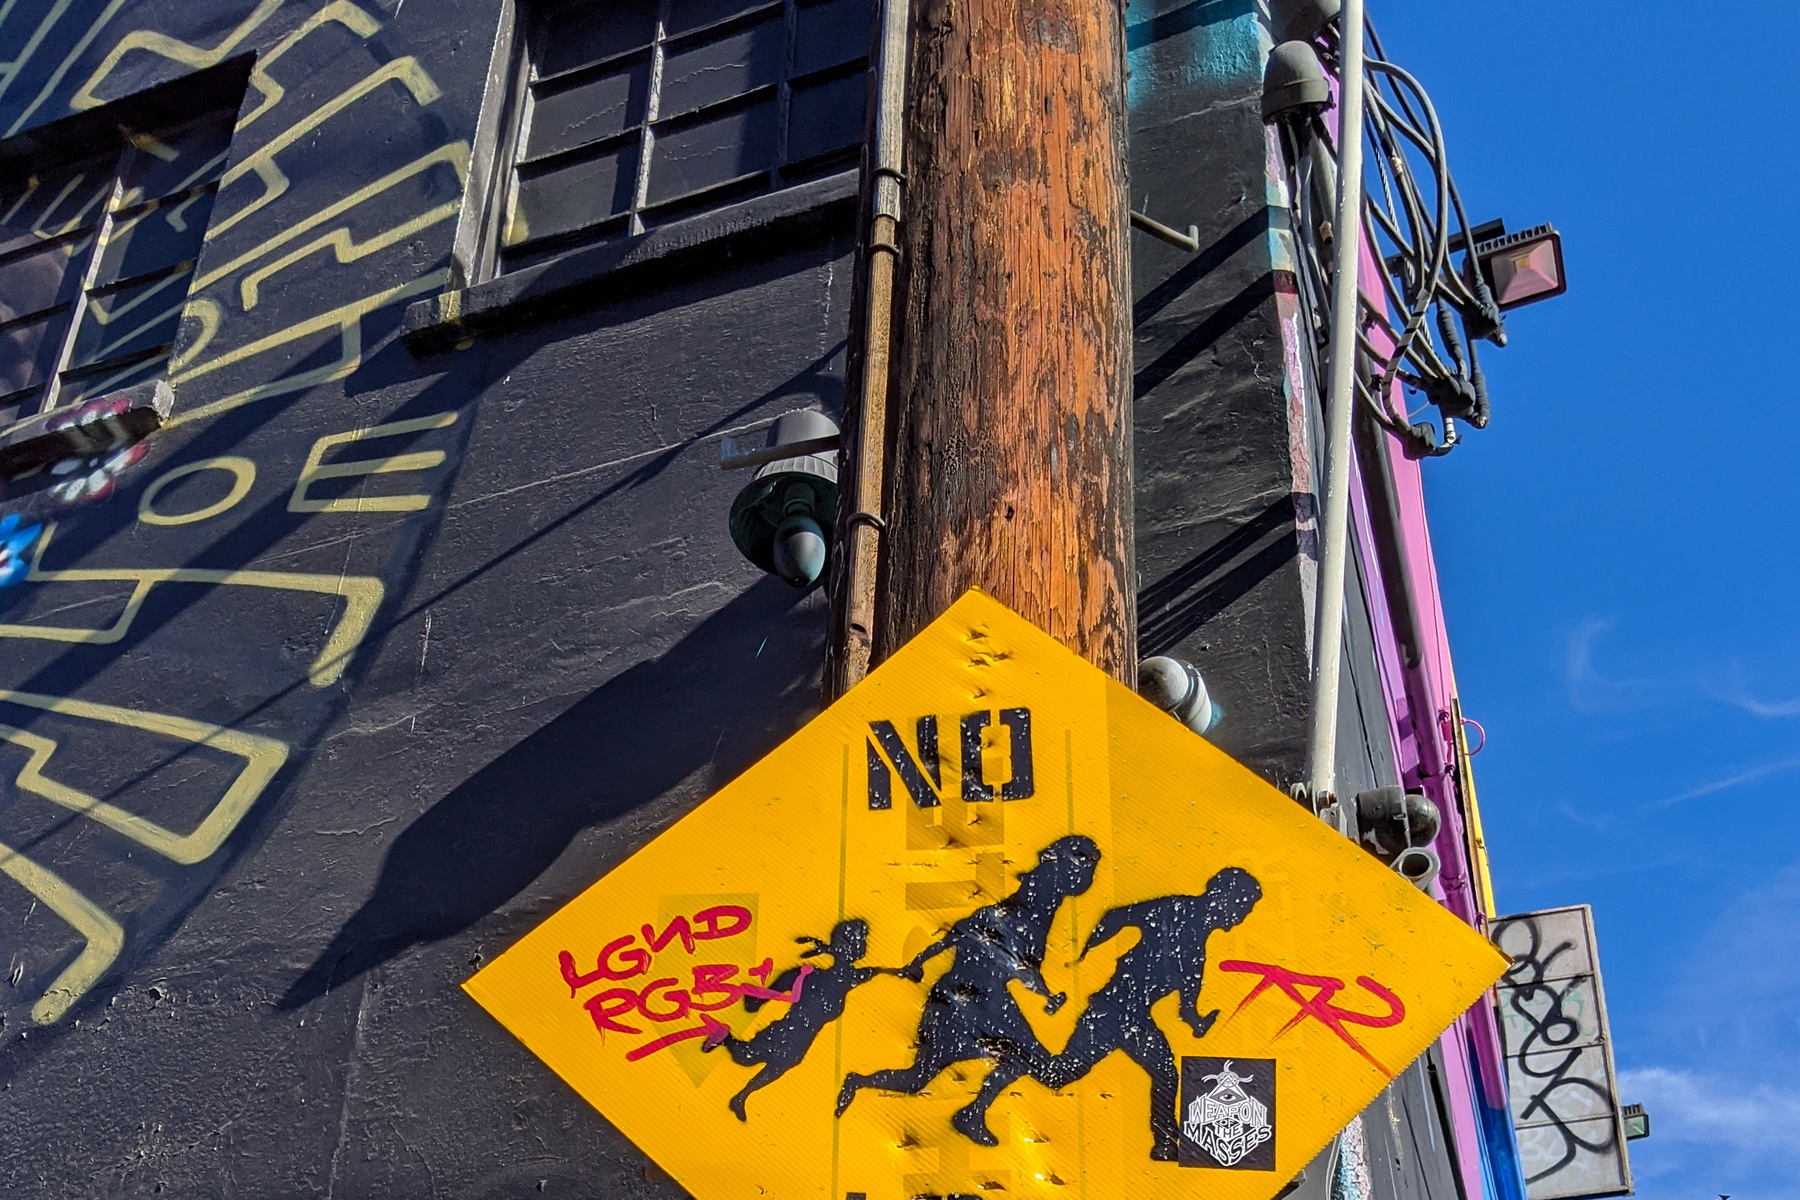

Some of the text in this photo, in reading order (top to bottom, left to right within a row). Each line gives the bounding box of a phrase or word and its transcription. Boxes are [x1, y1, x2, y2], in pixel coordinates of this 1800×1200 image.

[866, 707, 1034, 810] NO
[1189, 1093, 1268, 1128] WEAPON
[1184, 1120, 1273, 1166] MASSES
[1215, 1121, 1243, 1141] THE
